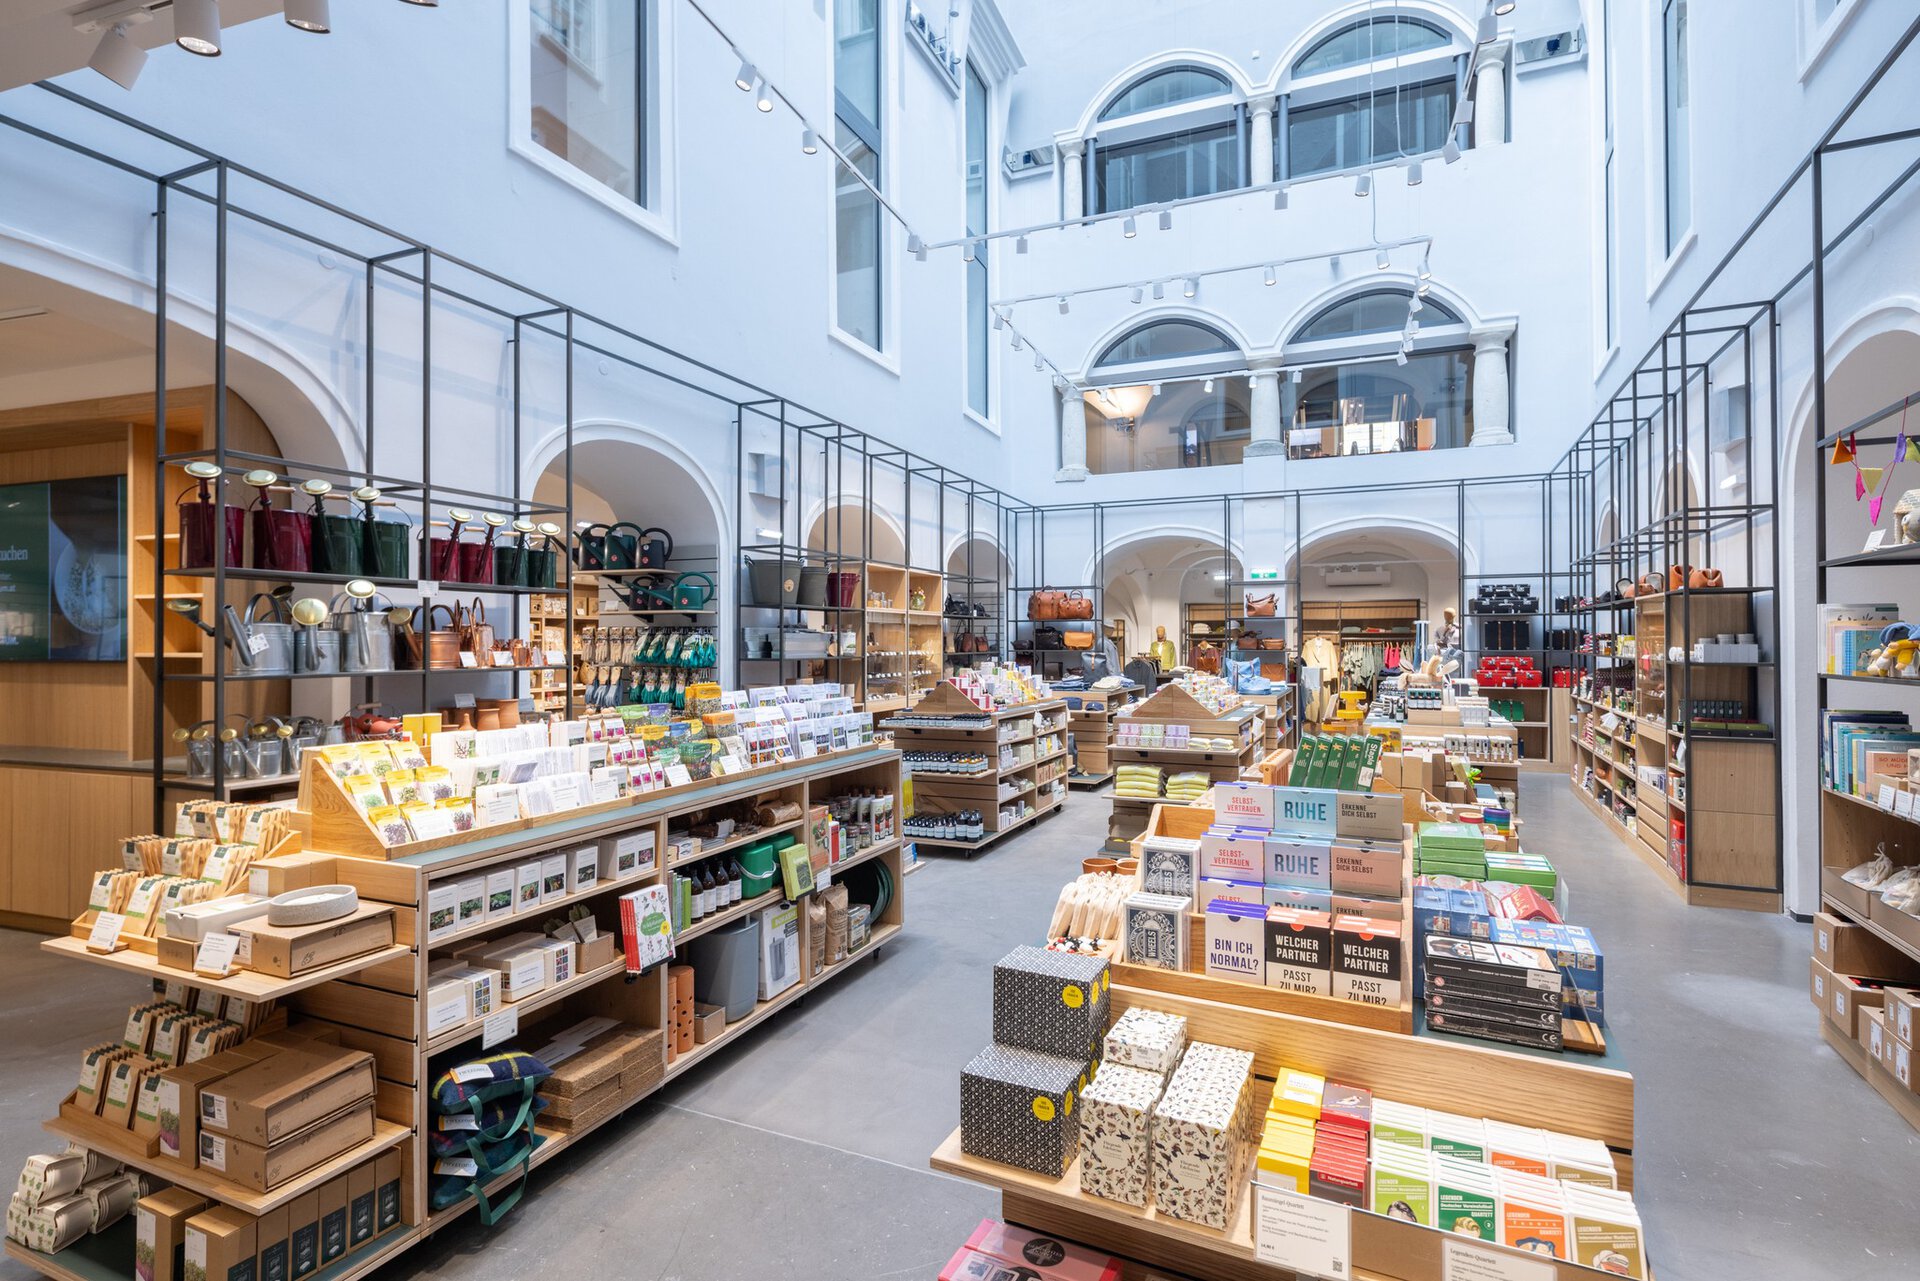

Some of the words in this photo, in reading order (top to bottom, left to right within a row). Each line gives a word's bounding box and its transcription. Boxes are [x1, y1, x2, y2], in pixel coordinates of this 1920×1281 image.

[1232, 796, 1257, 805] SELBST-
[1341, 803, 1367, 811] ERKENNE
[1227, 804, 1261, 813] VERTRAUEN
[1284, 801, 1327, 821] RUHE
[1356, 811, 1377, 819] SELBST
[1219, 849, 1244, 857] SELBST-
[1214, 857, 1250, 867] VERTRAUEN
[1275, 854, 1319, 875] RUHE
[1336, 857, 1362, 866] ERKENNE
[1336, 864, 1350, 872] DICH
[1351, 865, 1373, 874] SELBST
[1336, 907, 1363, 917] ERKENNE
[1147, 931, 1157, 958] WHEELS
[1214, 938, 1232, 952] BIN
[1235, 941, 1253, 955] ICH
[1275, 935, 1319, 951] WELCHER
[1276, 947, 1318, 963] PARTNER
[1343, 943, 1390, 961] WELCHER
[1210, 953, 1259, 971] NORMAL?
[1344, 957, 1389, 974] PARTNER
[1283, 969, 1312, 983] PASST
[1351, 979, 1382, 994] PASST
